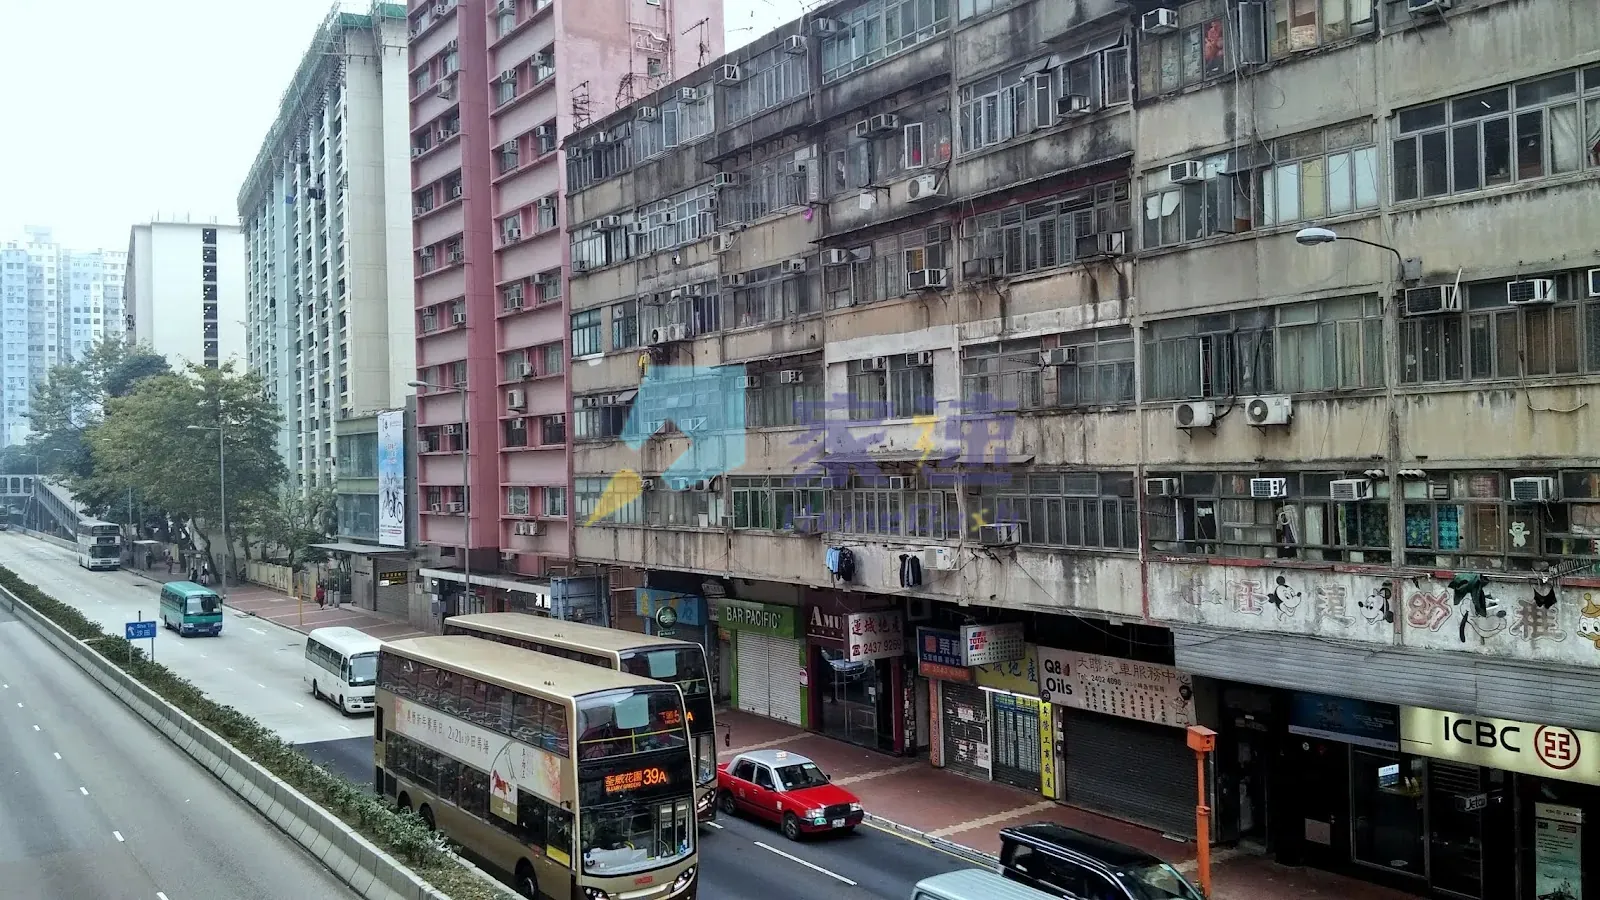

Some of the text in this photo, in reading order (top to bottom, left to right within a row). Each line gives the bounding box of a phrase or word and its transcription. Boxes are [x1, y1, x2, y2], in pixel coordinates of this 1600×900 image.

[726, 606, 778, 629] BAR PACIFIC
[810, 606, 843, 629] AMU
[863, 642, 882, 655] 2437
[969, 637, 988, 645] TOTAL
[1044, 658, 1062, 675] Q8
[1078, 655, 1192, 686] 大聯汽車服務中心
[1045, 677, 1073, 696] Oils
[1444, 716, 1521, 753] ICBC
[643, 767, 667, 785] 39A
